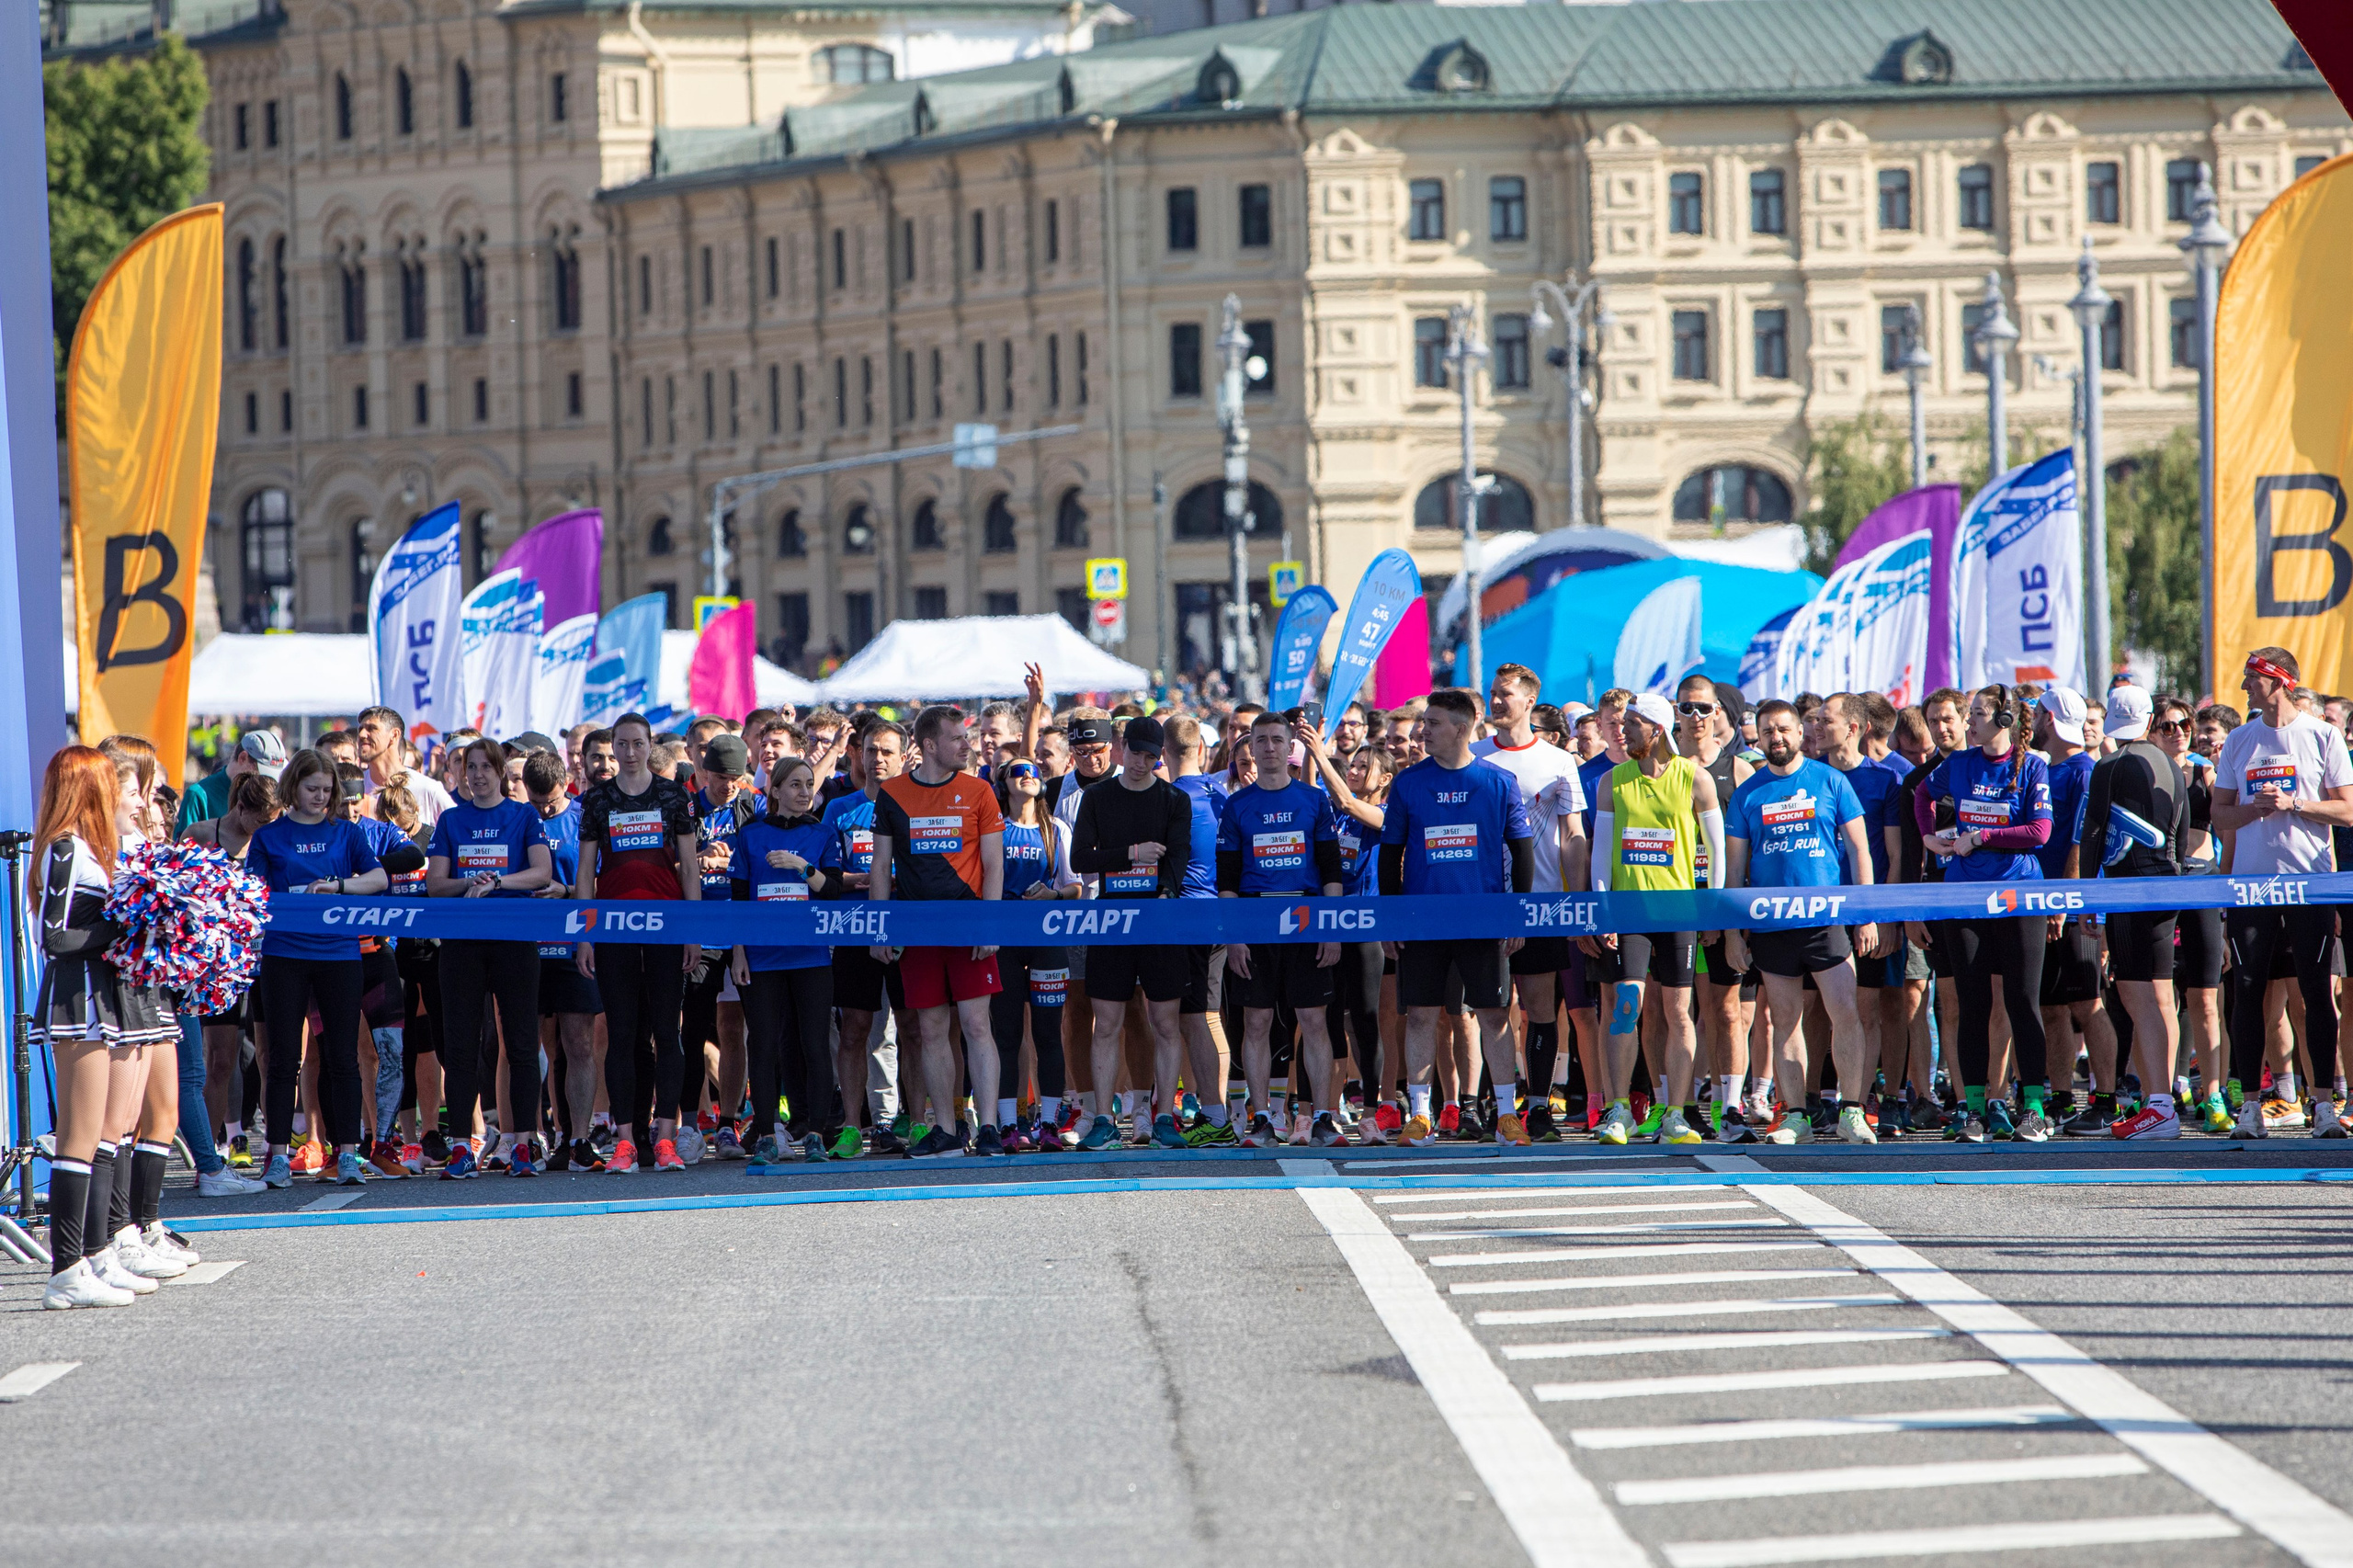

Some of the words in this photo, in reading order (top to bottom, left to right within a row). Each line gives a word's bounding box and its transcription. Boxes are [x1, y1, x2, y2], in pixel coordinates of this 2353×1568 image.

[2018, 562, 2053, 652] ПСБ
[1371, 608, 1389, 621] 4:45
[1361, 621, 1381, 640] 47
[1288, 650, 1306, 665] 50
[1437, 791, 1469, 803] ЗАБЕГ
[1263, 812, 1292, 824] ЗАБЕГ
[472, 828, 500, 839] ЗАБЕГ
[1771, 823, 1810, 835] 13761
[616, 835, 659, 847] 15022
[915, 840, 958, 850] 13740
[296, 843, 326, 854] ЗАБЕГ
[1006, 846, 1043, 861] ЗАБЕГ
[1430, 848, 1472, 859] 14263
[1809, 848, 1825, 858] club
[1258, 857, 1302, 868] 10350
[1628, 852, 1667, 863] 11983
[1112, 879, 1152, 889] 10154
[2024, 891, 2085, 910] ПСБ
[1749, 895, 1847, 920] СТАРТ
[322, 906, 425, 927] СТАРТ
[605, 911, 665, 931] ПСБ
[1041, 908, 1141, 935] СТАРТ
[1317, 908, 1376, 930] ПСБ
[1036, 993, 1066, 1004] 11618
[2133, 1115, 2158, 1131] HOKA
